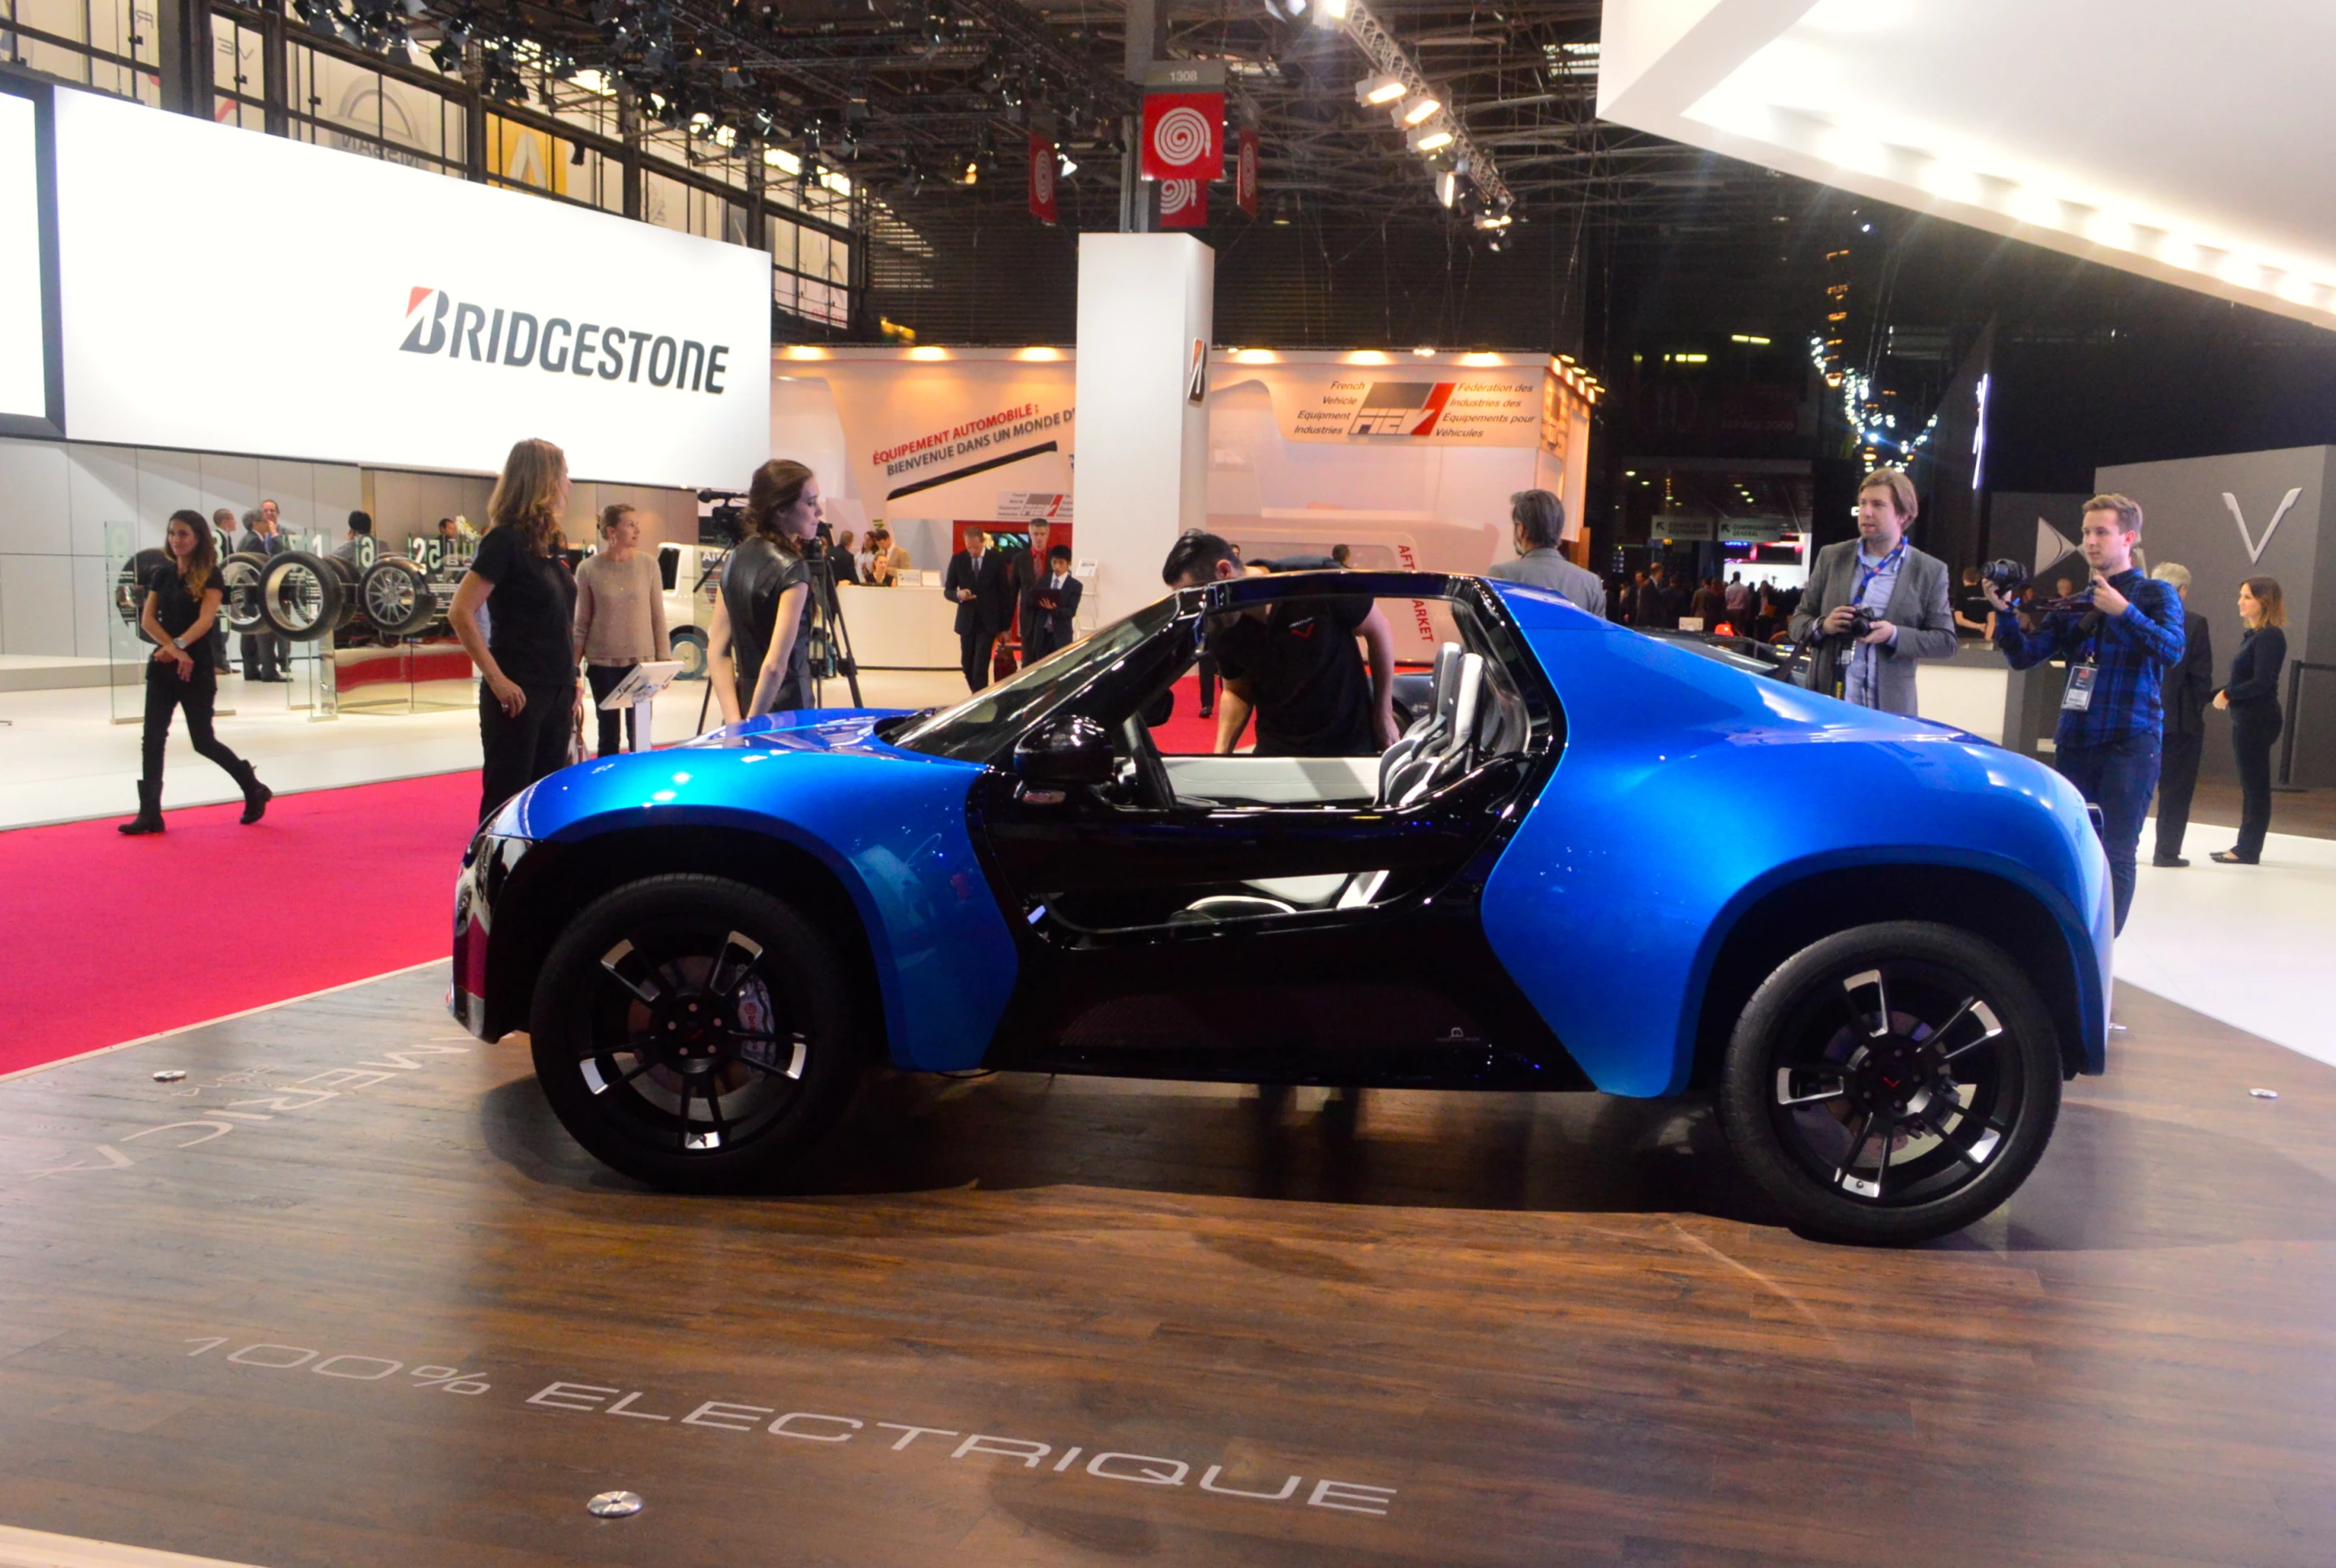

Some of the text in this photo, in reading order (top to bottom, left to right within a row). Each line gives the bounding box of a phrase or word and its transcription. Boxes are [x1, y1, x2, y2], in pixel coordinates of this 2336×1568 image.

[1170, 70, 1198, 82] 1308
[398, 286, 729, 395] BRIDGESTONE
[1330, 380, 1366, 390] French
[1457, 383, 1534, 393] Fédération des
[1323, 395, 1358, 405] Vehicle
[1450, 398, 1522, 408] Industries des
[1298, 410, 1351, 420] Equipment
[1509, 415, 1536, 424] pour
[873, 430, 950, 466] ÉQUIPEMENT
[952, 402, 1033, 440] AUTOMOBILE
[1294, 425, 1343, 435] Industries
[1436, 427, 1484, 437] Véhicules
[887, 447, 955, 476] BIENVENUE
[957, 436, 991, 455] DANS
[994, 426, 1011, 443] UN
[1013, 412, 1062, 436] MONDE
[184, 1336, 1397, 1516] 100% ELECTRIQUE
